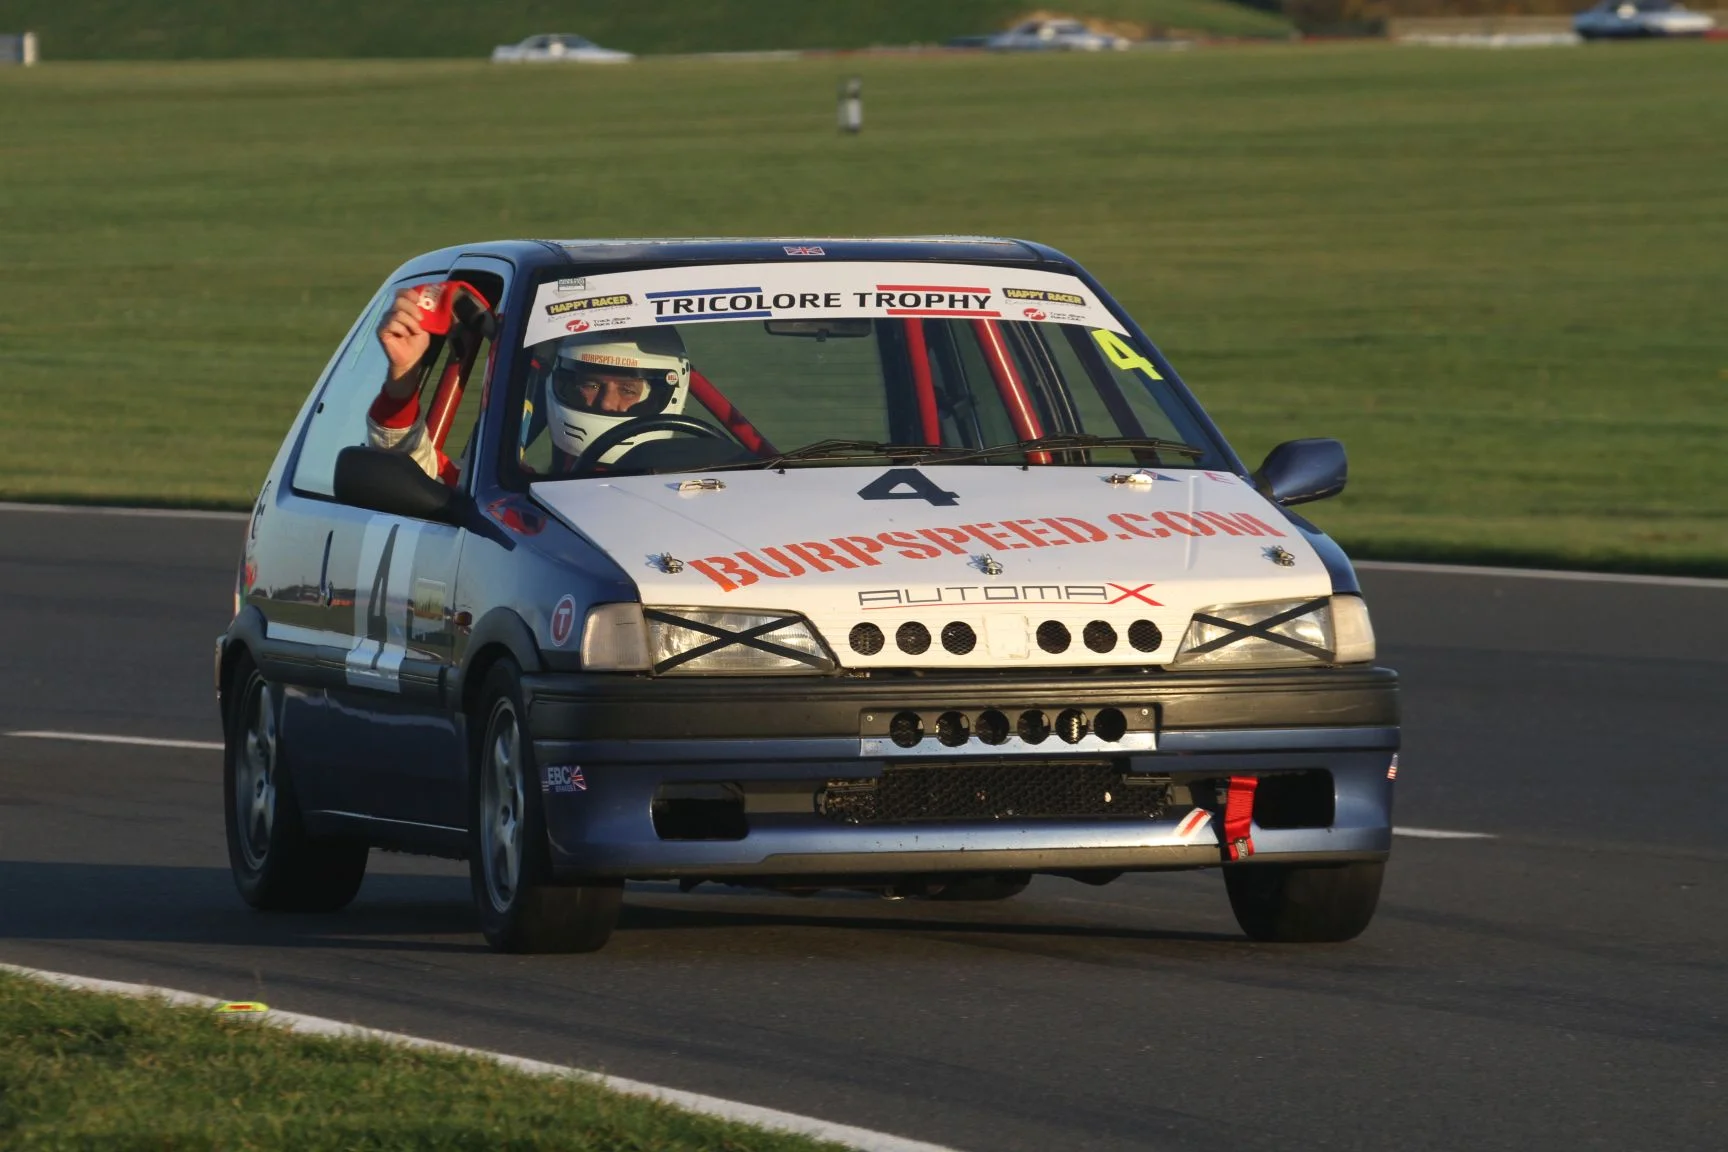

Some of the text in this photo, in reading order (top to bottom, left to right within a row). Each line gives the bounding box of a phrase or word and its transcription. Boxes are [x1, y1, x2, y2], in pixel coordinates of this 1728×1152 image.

[550, 299, 589, 314] HAPPY
[591, 295, 629, 307] RACER
[651, 292, 842, 316] TRICOLORE
[853, 291, 991, 310] TROPHY
[1006, 289, 1045, 299] HAPPY
[1046, 292, 1083, 305] RACER
[1091, 328, 1164, 381] 4
[857, 468, 961, 507] 4
[687, 510, 1288, 593] BURPSPEED.COM
[367, 523, 401, 670] 4
[857, 582, 1165, 607] AUTOMAX
[558, 607, 571, 636] T
[547, 766, 572, 786] EBC
